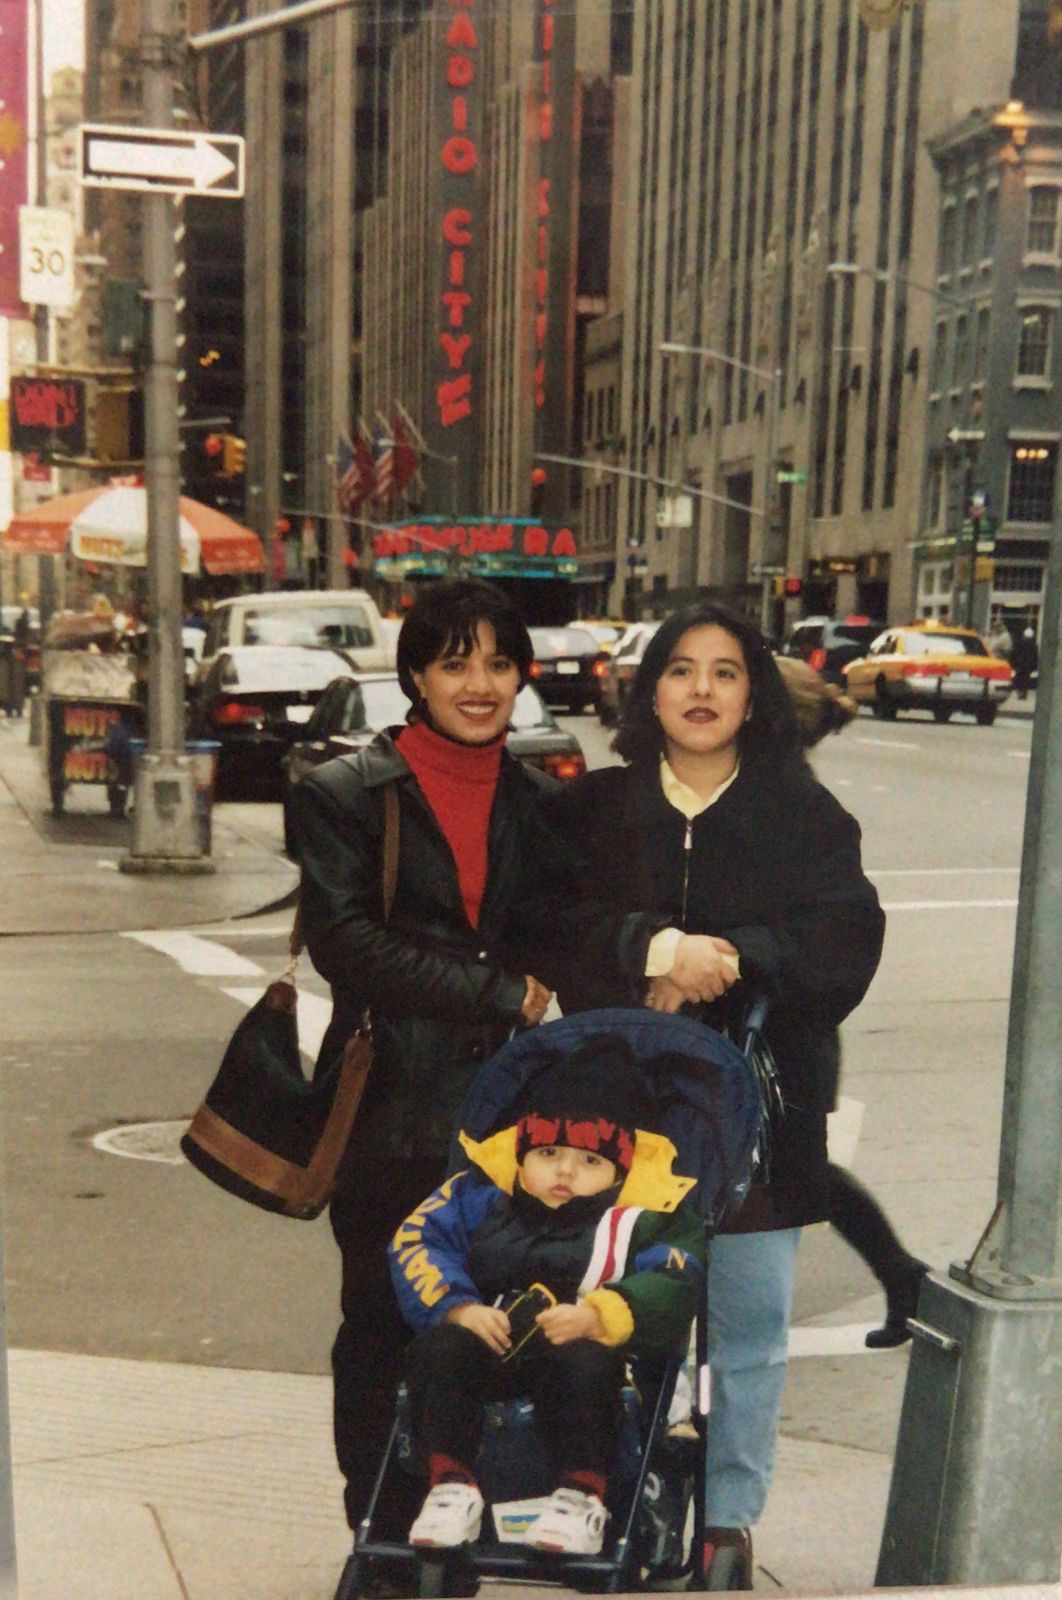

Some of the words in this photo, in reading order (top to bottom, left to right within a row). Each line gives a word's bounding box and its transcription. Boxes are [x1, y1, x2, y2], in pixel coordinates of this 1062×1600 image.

[442, 0, 476, 173] ADIO
[29, 246, 65, 277] 30
[441, 209, 470, 368] CITY
[665, 1247, 690, 1270] N
